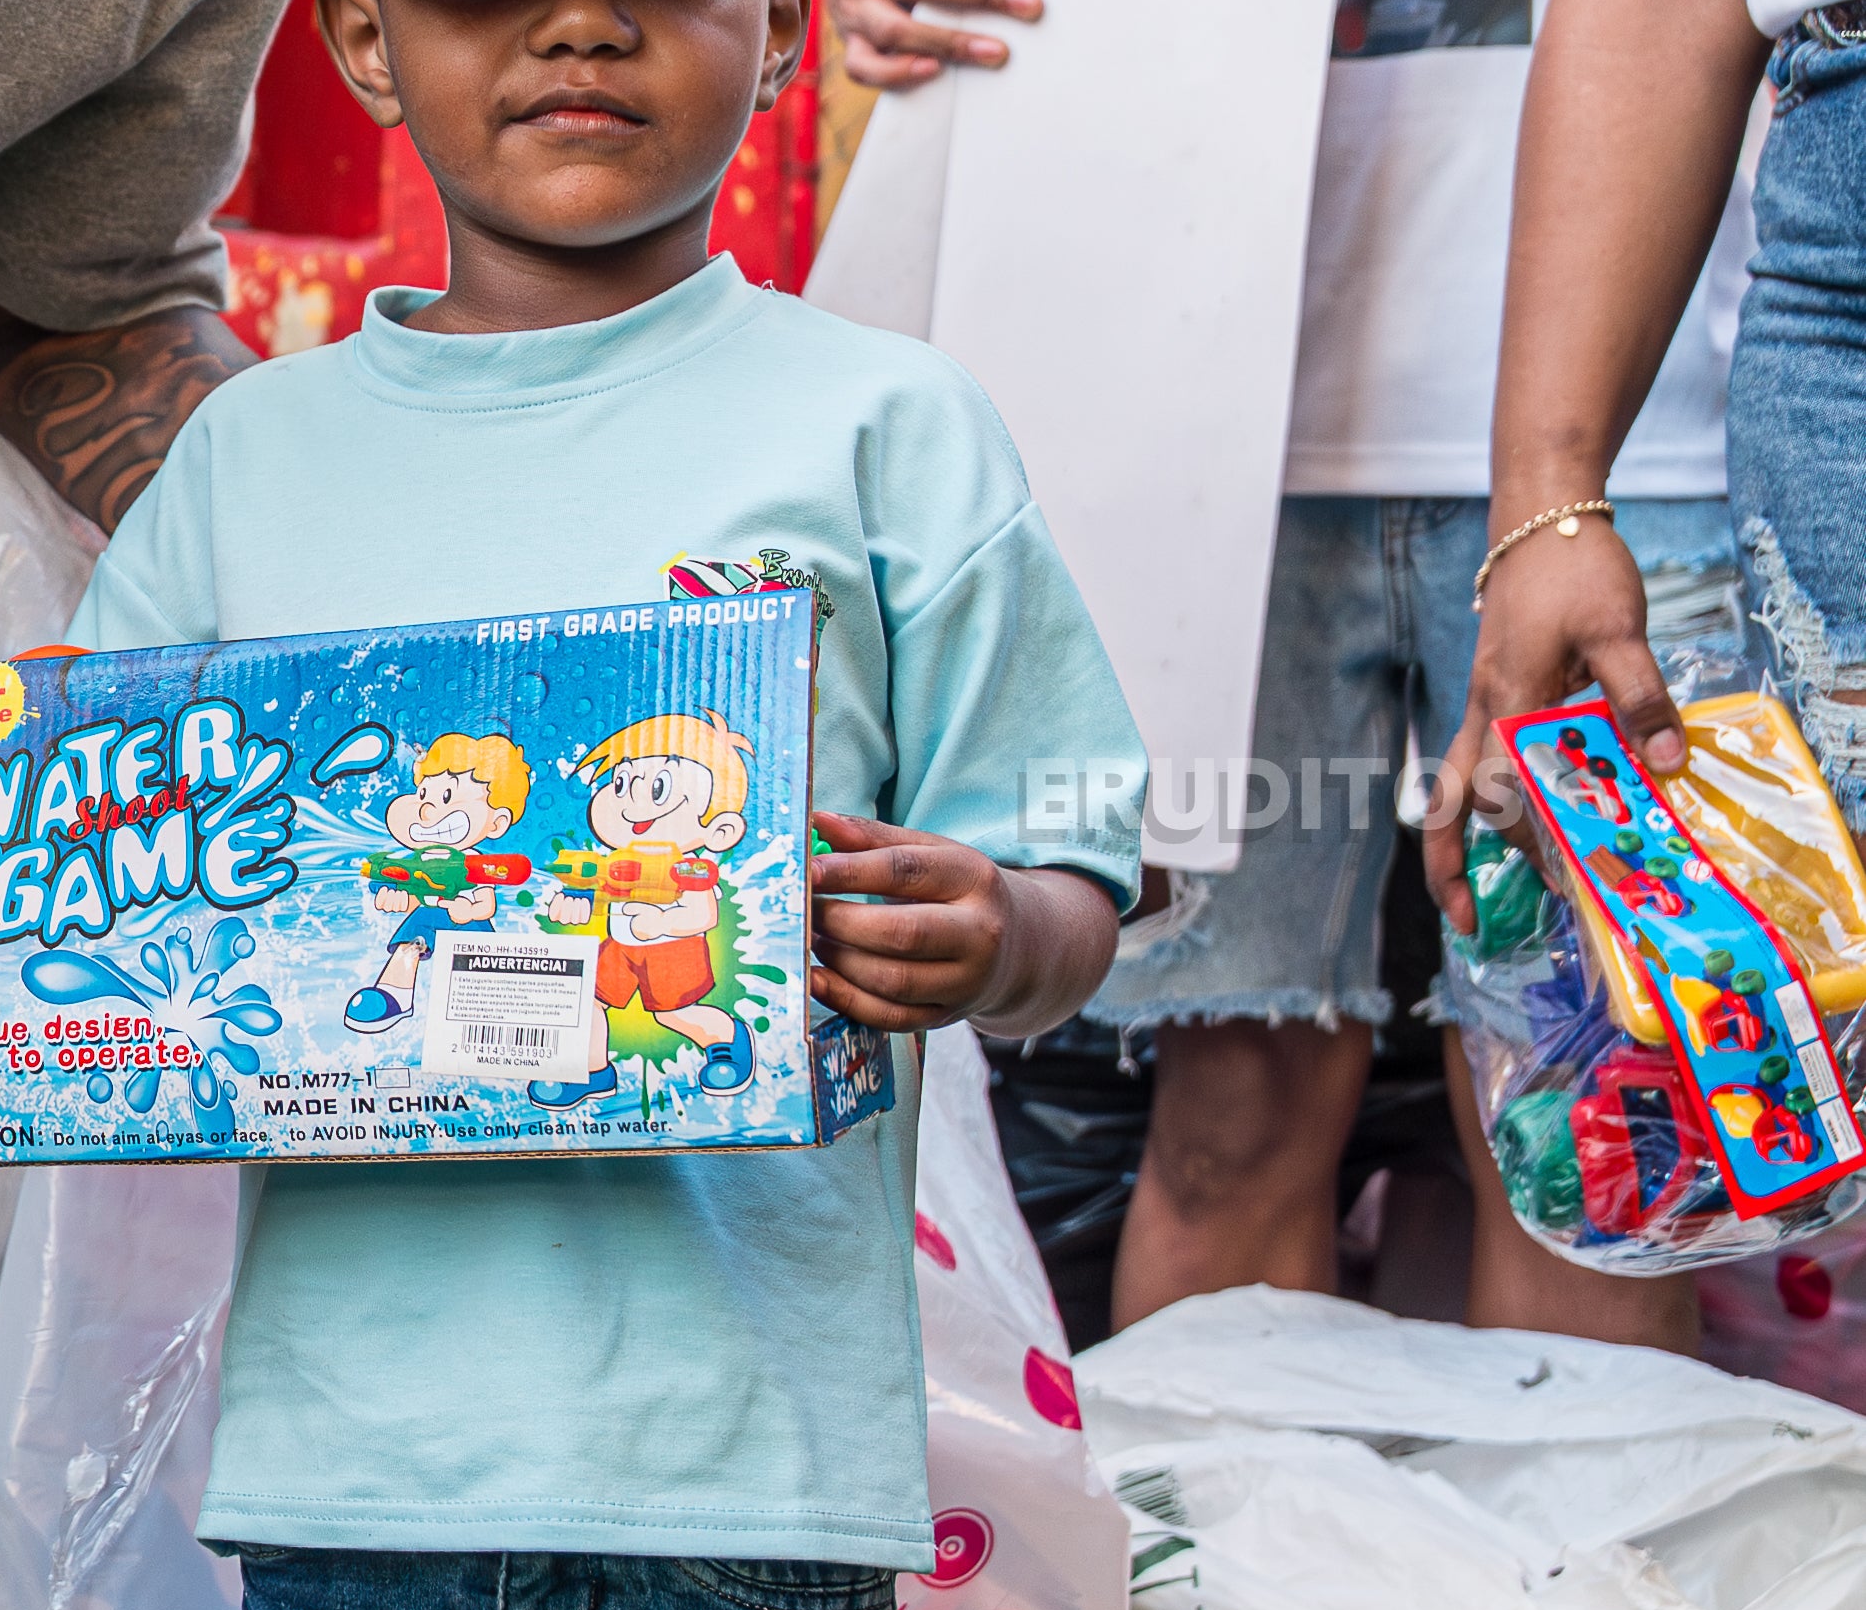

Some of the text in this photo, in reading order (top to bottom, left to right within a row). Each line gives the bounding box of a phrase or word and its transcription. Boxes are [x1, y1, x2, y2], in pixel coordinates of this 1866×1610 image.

[477, 596, 796, 646] FIRST GRADE PRODUCT
[67, 775, 191, 843] Shoot
[453, 943, 475, 952] ITEM
[468, 956, 567, 972] ¡ADVERTENCIA!
[44, 1015, 164, 1045] design,
[8, 1047, 43, 1070] to
[58, 1045, 204, 1074] operate,
[465, 1044, 506, 1055] 014143
[476, 1056, 540, 1067] MADE IN CHINA
[263, 1094, 470, 1118] MADE IN CHINA
[832, 1063, 882, 1120] GAME
[53, 1132, 75, 1147] Do
[80, 1131, 107, 1146] not
[112, 1130, 140, 1145] aim
[165, 1130, 204, 1146] eyas
[209, 1130, 228, 1143] or
[233, 1128, 273, 1143] face.
[289, 1127, 306, 1141] to
[313, 1125, 366, 1141] AVOID
[483, 1122, 521, 1139] only
[528, 1119, 576, 1137] clean
[582, 1118, 610, 1137] tap
[617, 1117, 673, 1135] water.
